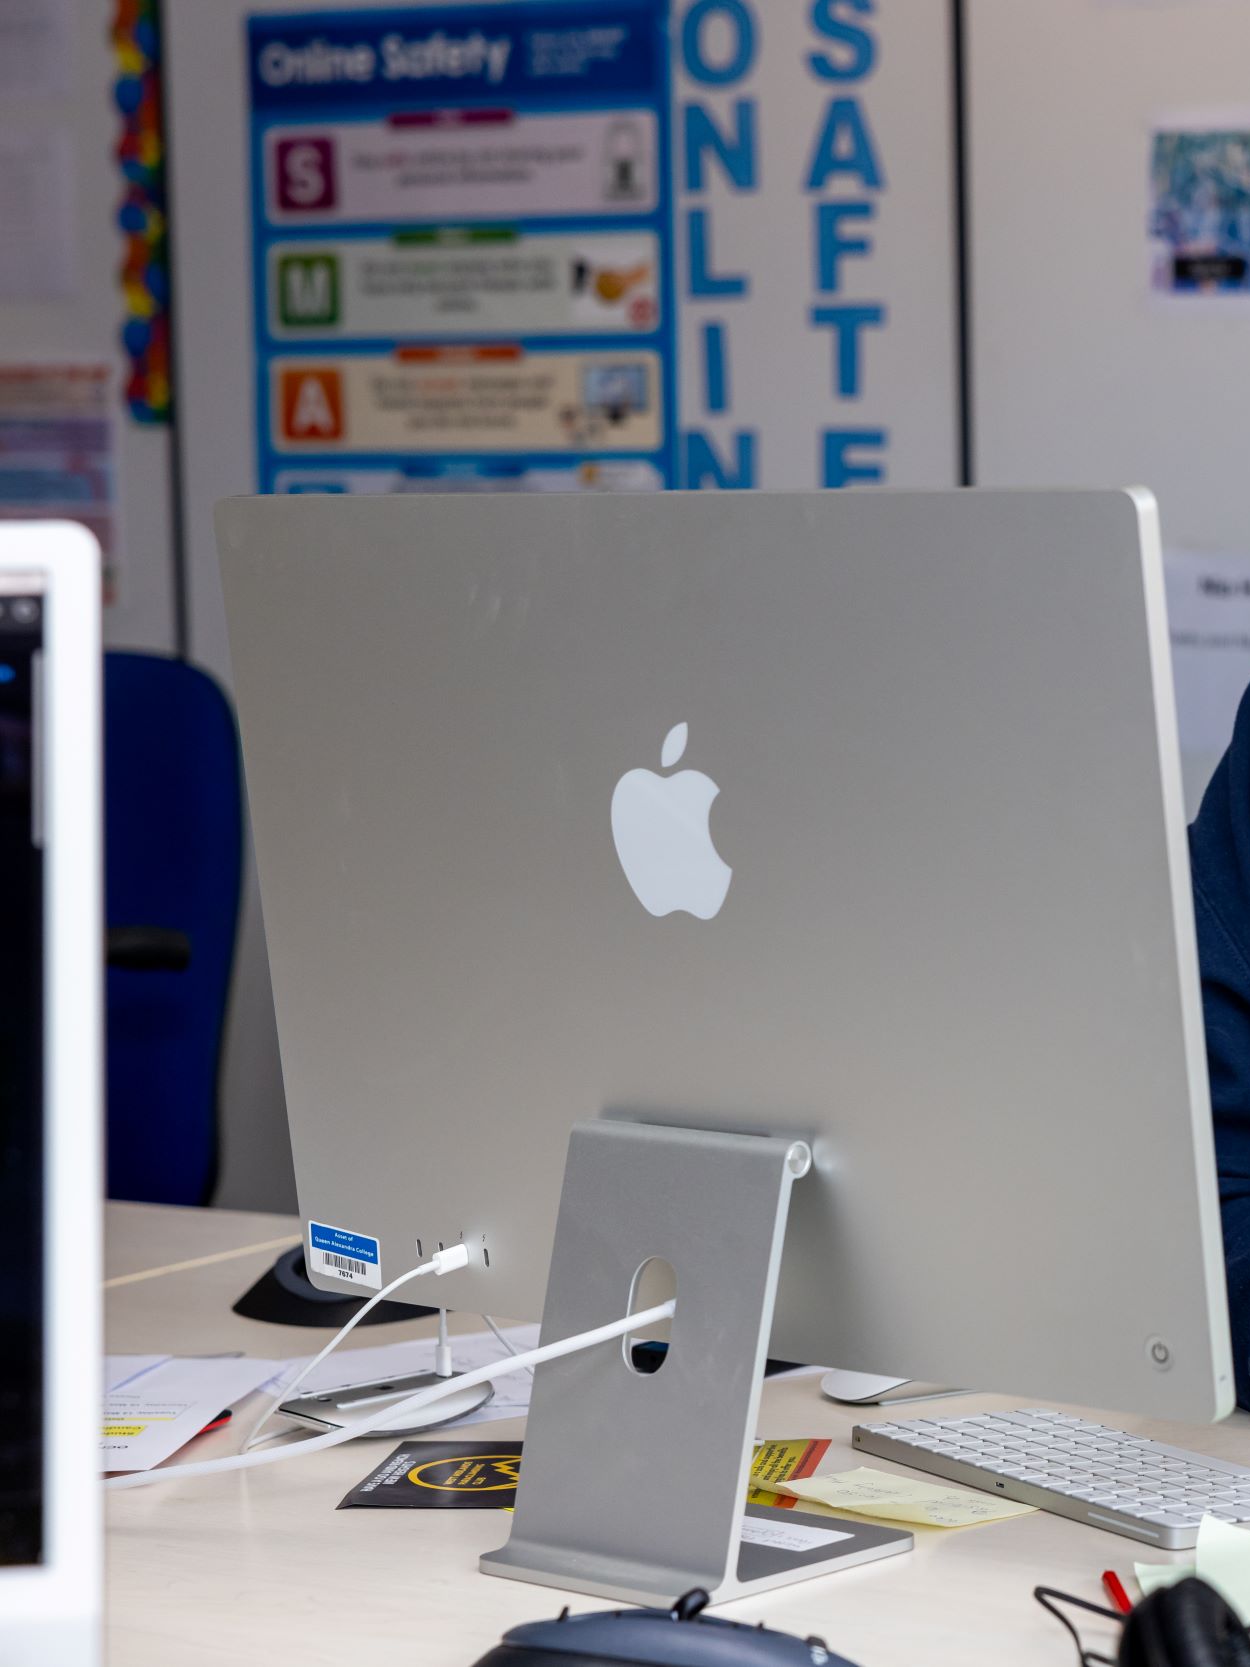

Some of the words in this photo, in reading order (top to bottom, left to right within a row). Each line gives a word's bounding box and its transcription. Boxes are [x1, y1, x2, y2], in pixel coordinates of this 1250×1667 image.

[261, 41, 375, 84] Online
[382, 34, 510, 83] Safety
[285, 145, 325, 205] S
[287, 262, 334, 321] M
[291, 379, 333, 433] A
[314, 1236, 330, 1245] Queen
[331, 1240, 356, 1252] Alexandra
[355, 1247, 374, 1257] College
[334, 1232, 347, 1241] Asset
[338, 1269, 353, 1279] 7674
